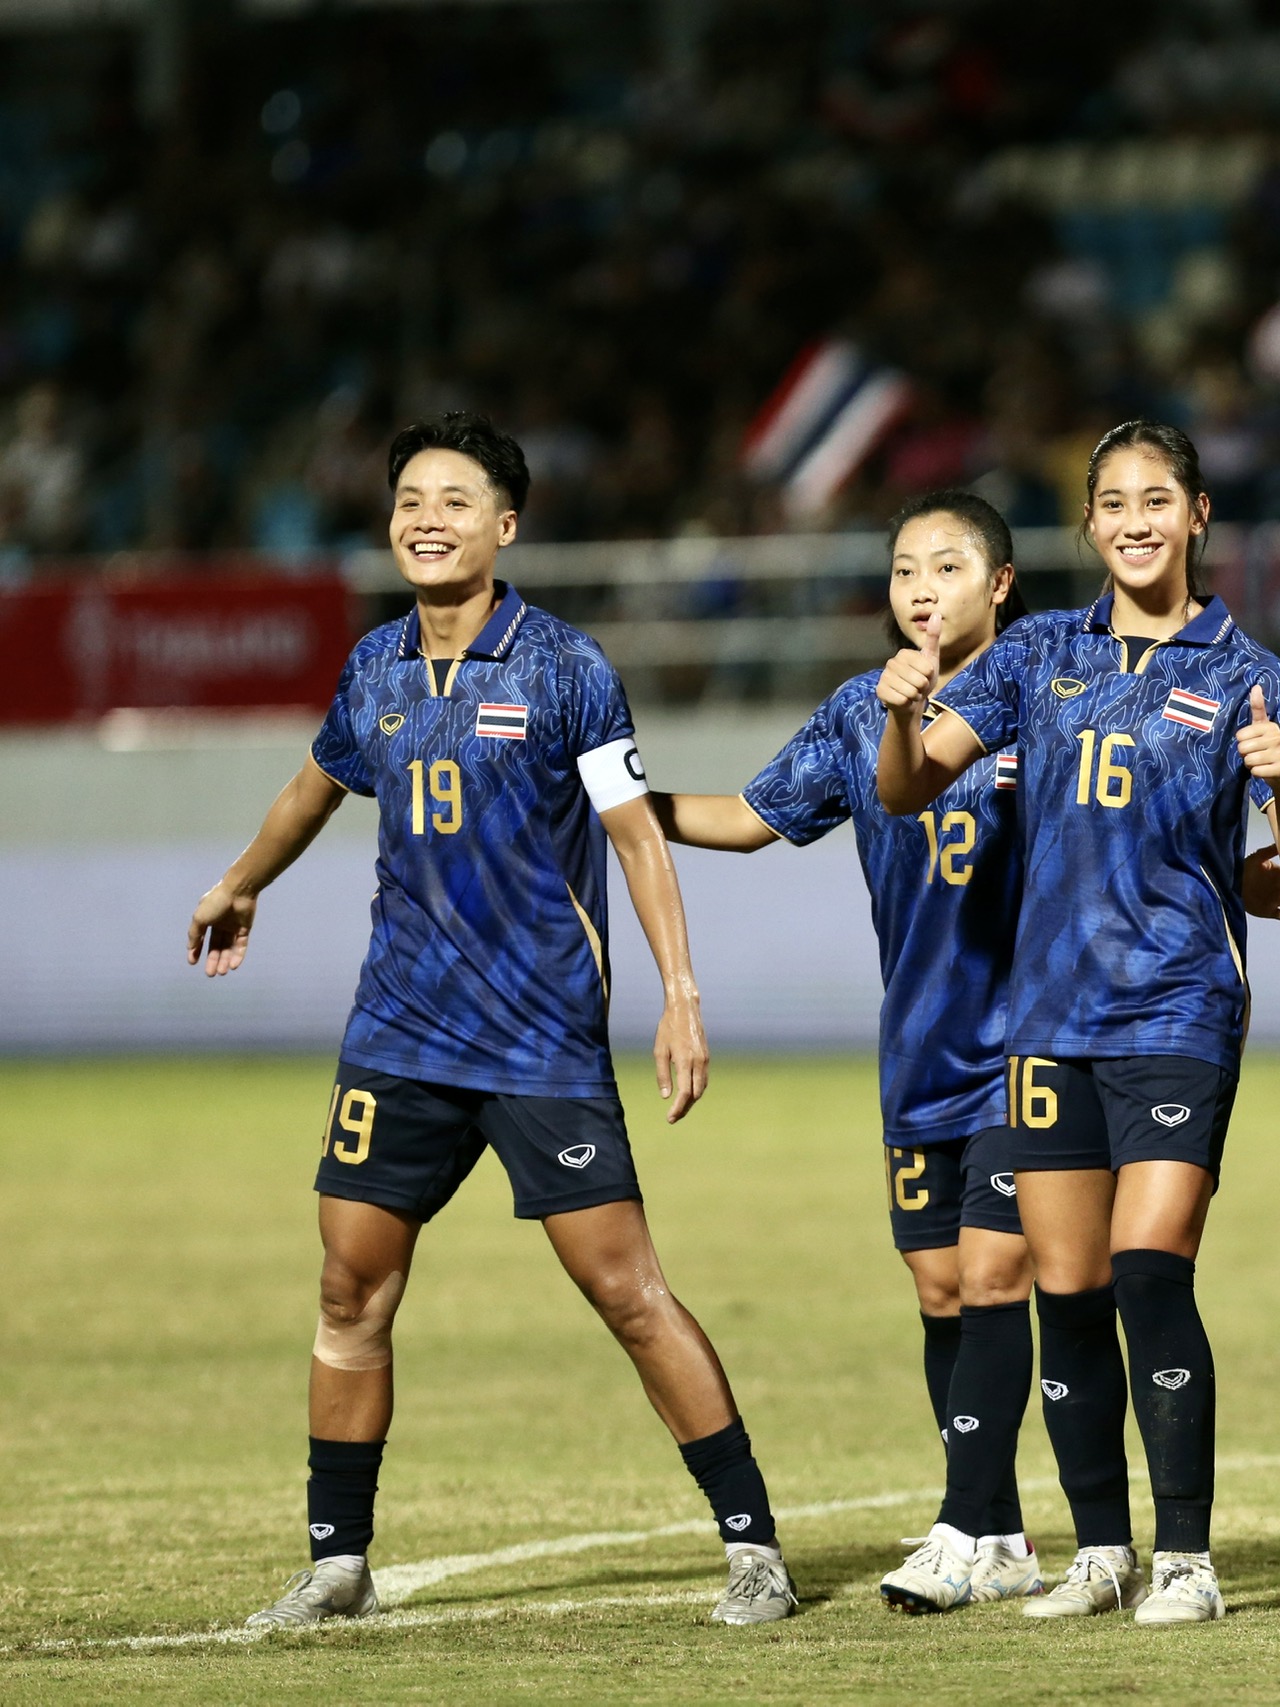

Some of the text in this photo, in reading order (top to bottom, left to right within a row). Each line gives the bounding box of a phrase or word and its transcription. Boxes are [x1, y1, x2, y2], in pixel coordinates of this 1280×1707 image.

[407, 759, 463, 835] 19
[1076, 729, 1136, 808] 16
[918, 811, 976, 886] 12
[322, 1084, 377, 1165] 19
[1007, 1056, 1058, 1129] 16
